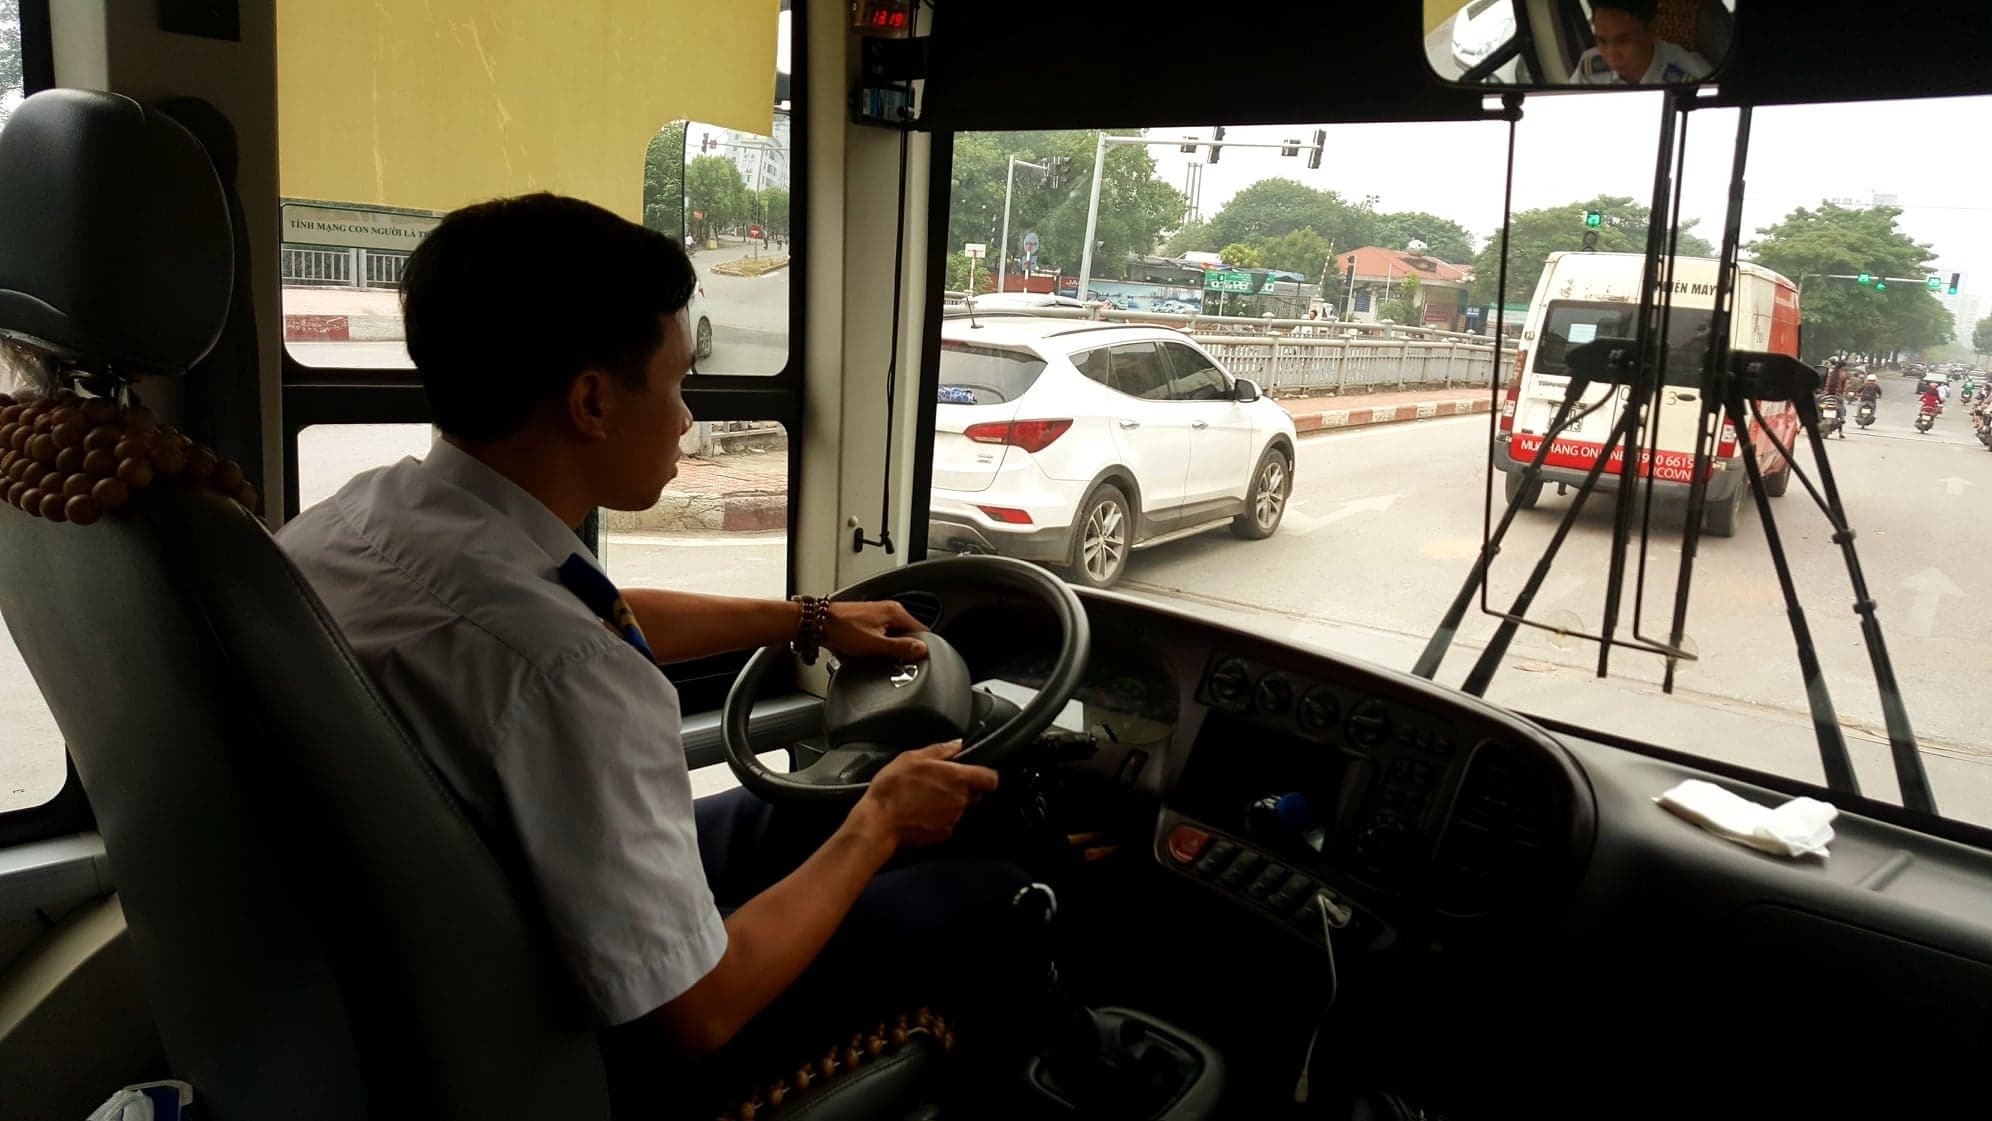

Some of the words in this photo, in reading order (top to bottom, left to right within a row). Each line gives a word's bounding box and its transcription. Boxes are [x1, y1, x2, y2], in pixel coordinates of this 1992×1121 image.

[290, 218, 314, 229] TÍNH
[316, 222, 346, 232] MẠNG
[348, 225, 369, 234] CON
[1636, 451, 1664, 466] 190
